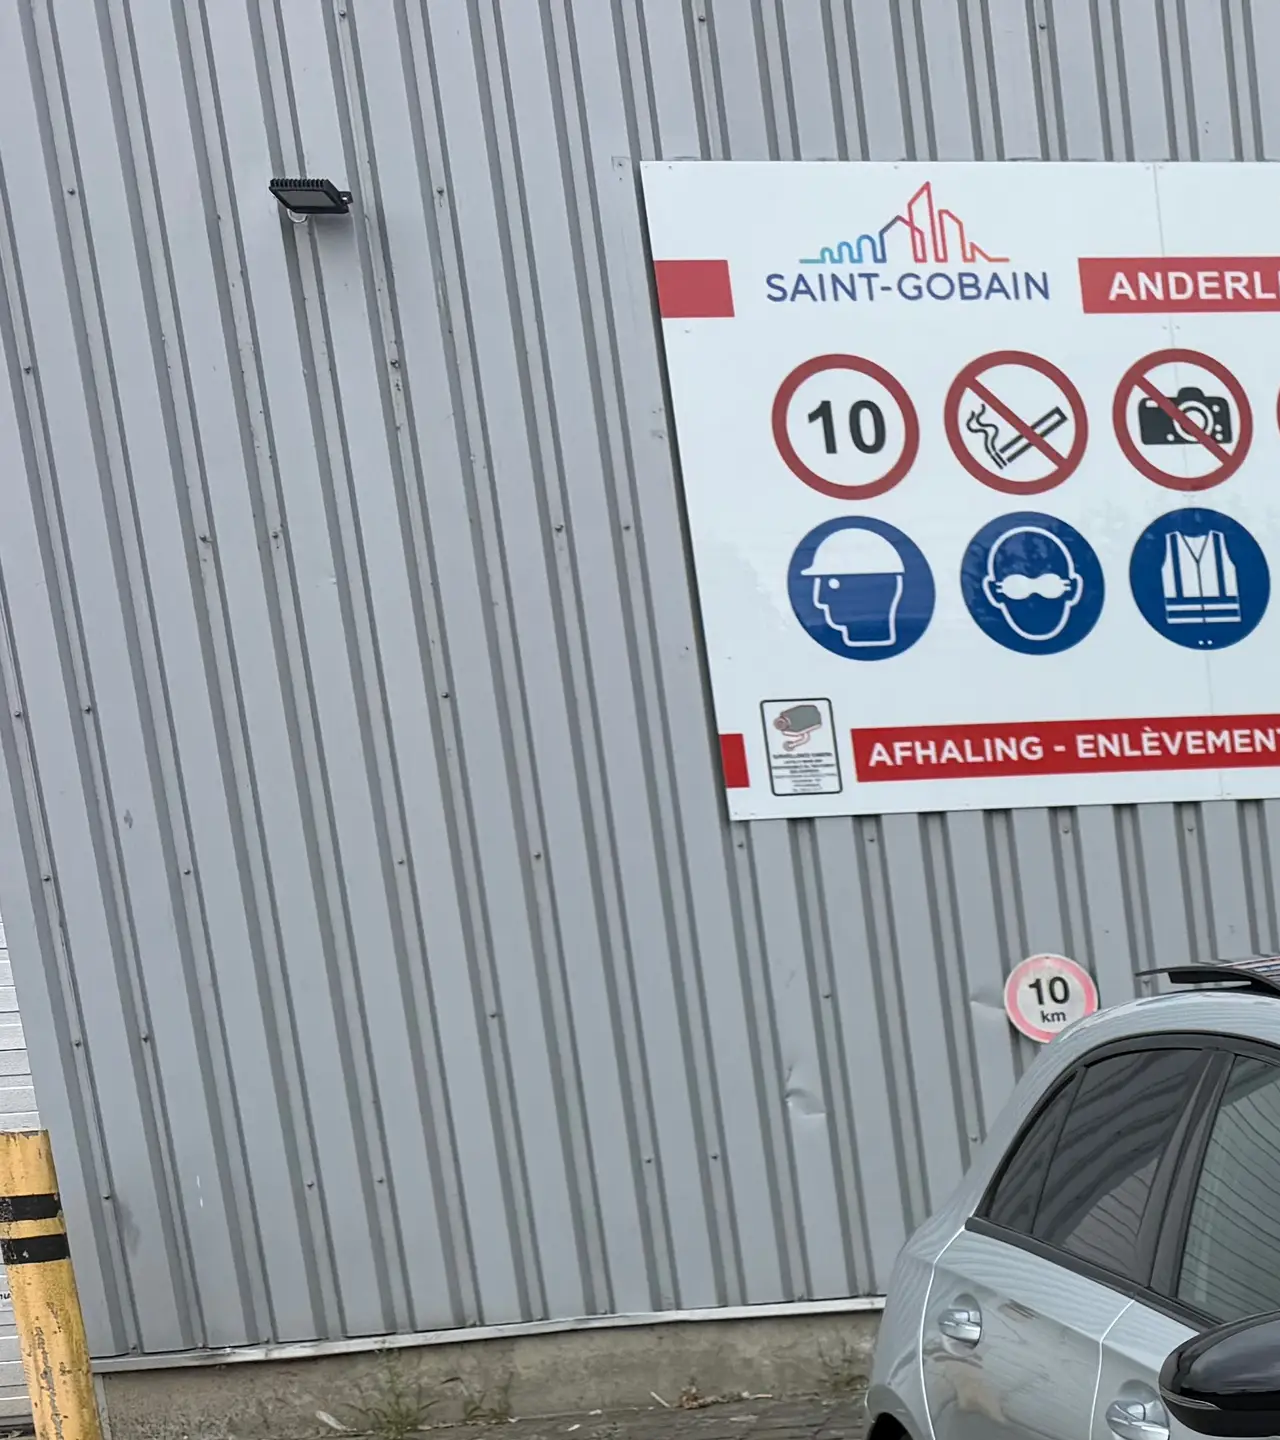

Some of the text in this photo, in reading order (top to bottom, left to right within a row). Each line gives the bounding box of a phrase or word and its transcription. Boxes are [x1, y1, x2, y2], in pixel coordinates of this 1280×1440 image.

[765, 271, 1050, 303] SAINT-GOBAIN
[807, 399, 886, 454] 10
[869, 736, 1043, 767] AFHALING
[1028, 976, 1070, 1006] 10
[1040, 1010, 1067, 1024] km
